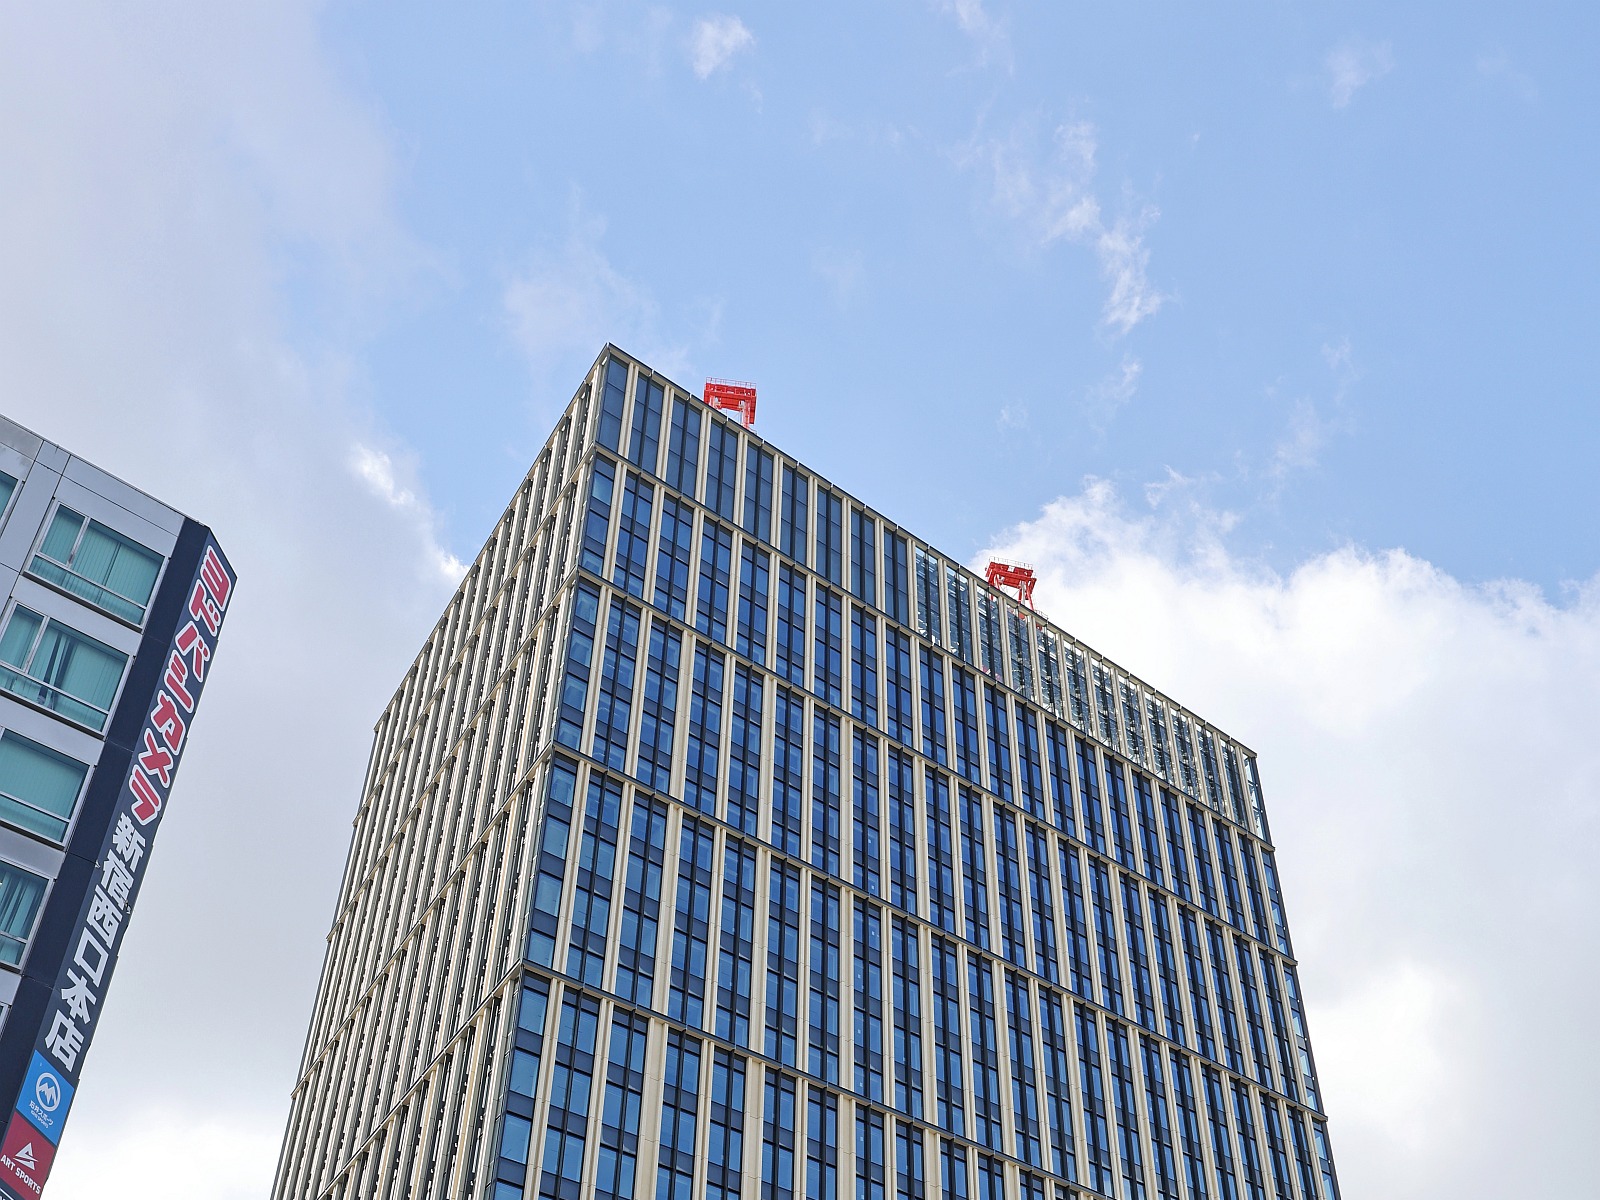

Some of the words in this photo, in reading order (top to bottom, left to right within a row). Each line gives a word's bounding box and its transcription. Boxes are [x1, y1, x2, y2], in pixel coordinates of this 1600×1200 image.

[128, 545, 231, 826] ヨドバシカメラ
[45, 811, 146, 1072] 新宿西口本店
[0, 1154, 15, 1171] ART
[15, 1167, 42, 1195] SPORTS
